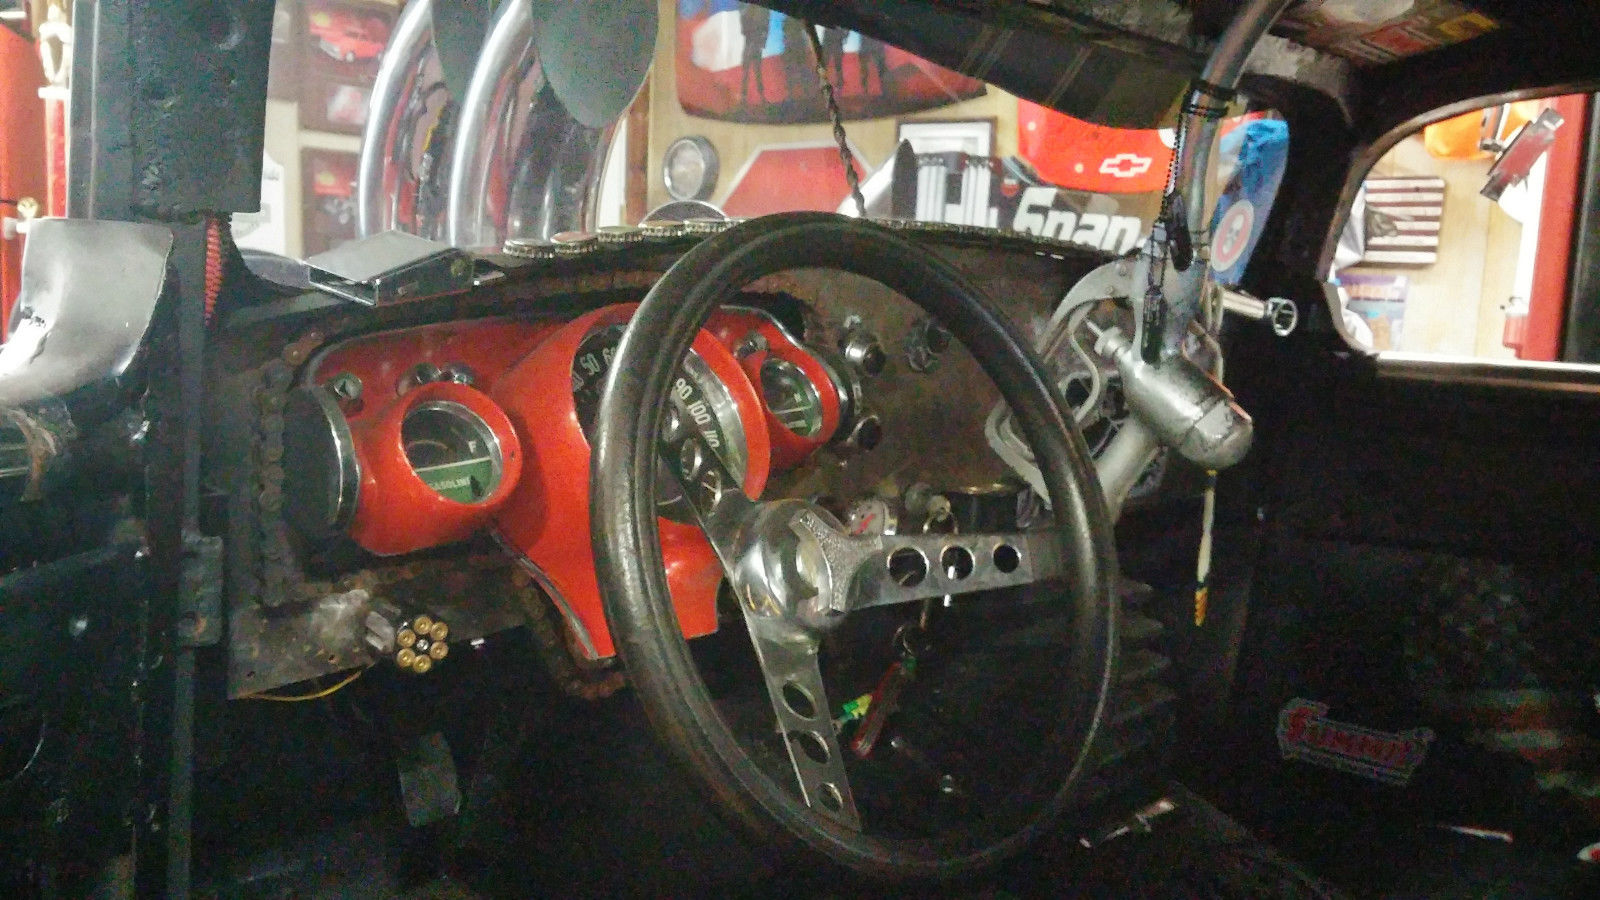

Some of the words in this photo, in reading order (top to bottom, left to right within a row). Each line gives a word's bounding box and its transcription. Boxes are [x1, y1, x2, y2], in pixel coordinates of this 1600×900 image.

[579, 353, 600, 376] 50
[675, 377, 693, 400] 90
[687, 400, 711, 425] 100
[468, 440, 477, 454] F
[703, 429, 720, 448] 110
